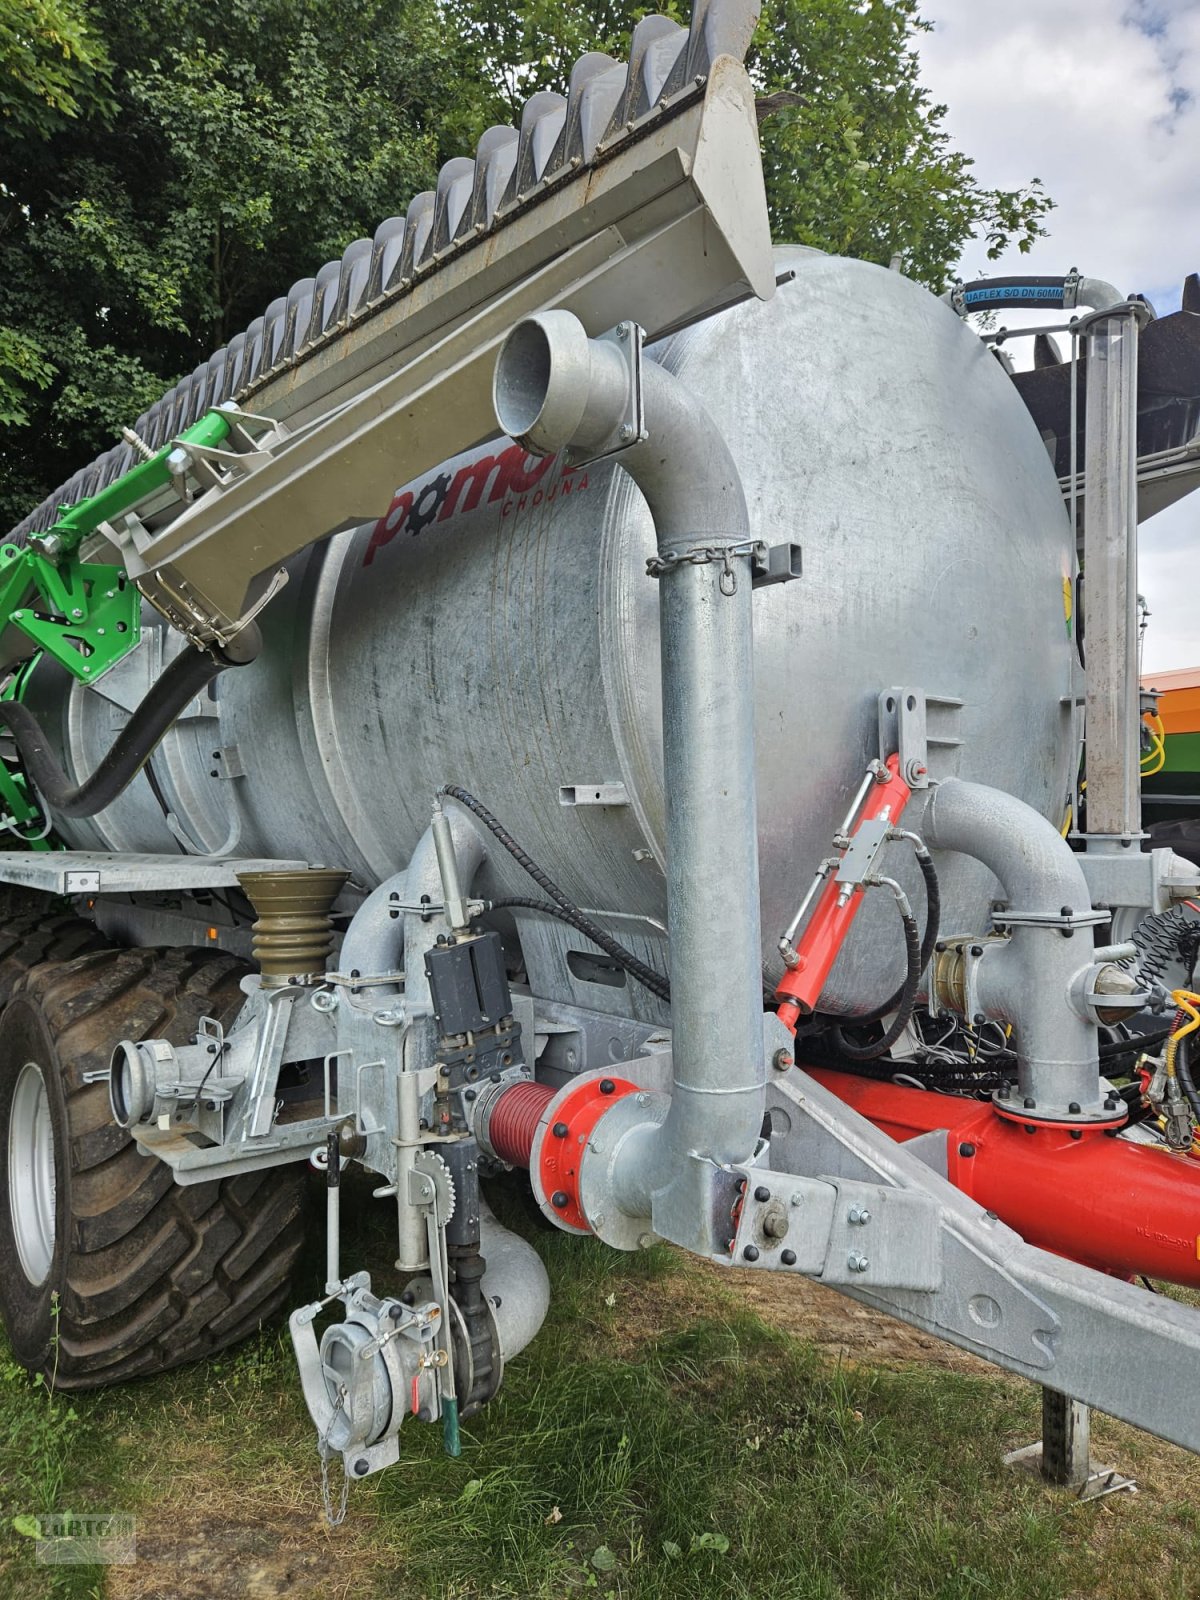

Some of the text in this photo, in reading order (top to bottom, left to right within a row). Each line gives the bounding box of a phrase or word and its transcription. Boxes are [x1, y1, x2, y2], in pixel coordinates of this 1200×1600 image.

[1004, 287, 1019, 298] S/D
[1021, 288, 1036, 298] DN
[362, 443, 578, 568] pomo
[502, 472, 589, 518] CHOJNA
